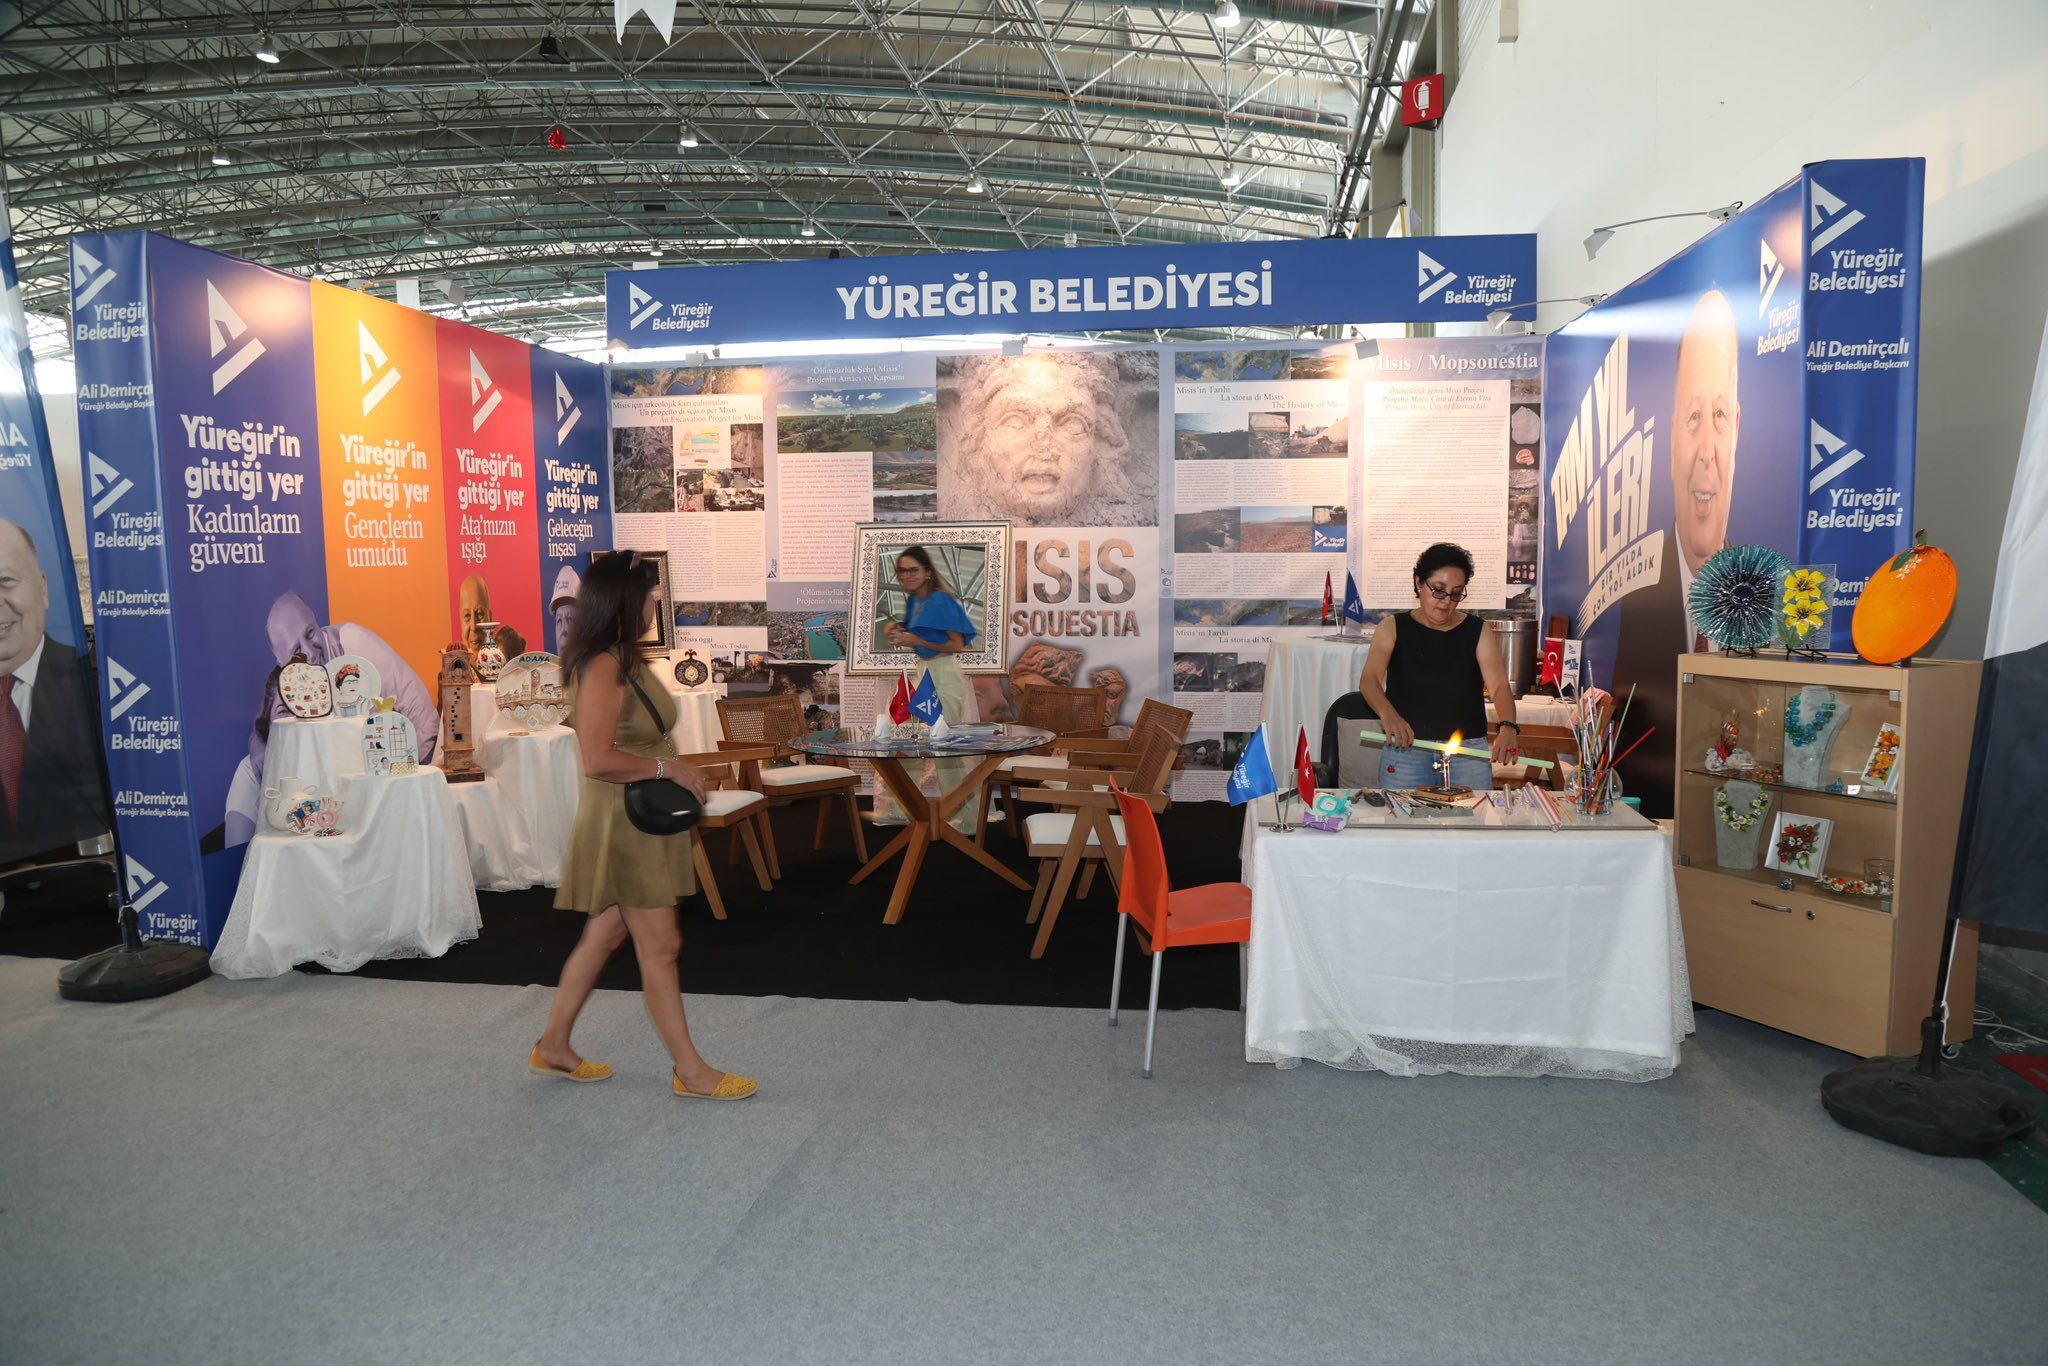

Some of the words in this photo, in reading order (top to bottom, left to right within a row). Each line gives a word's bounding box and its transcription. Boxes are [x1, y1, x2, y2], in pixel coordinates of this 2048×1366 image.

[1830, 248, 1903, 272] Yüreğir
[836, 270, 1017, 320] YÜREĞİR
[1030, 259, 1272, 313] BELEDİYESİ
[1467, 274, 1517, 291] Yüreğir
[1809, 268, 1906, 294] Belediyesi
[1444, 289, 1513, 306] Belediyesi
[670, 302, 713, 318] Yüreğir
[1768, 299, 1800, 329] Yüreğir
[652, 316, 710, 332] Belediyesi
[1757, 320, 1800, 356] Belediyesi
[1807, 341, 1826, 357] Ali
[1828, 338, 1909, 358] Demirçalı
[1429, 353, 1538, 373] Mopsouestia
[1806, 361, 1833, 373] Yüreğir
[1834, 360, 1872, 372] Belediye
[1873, 359, 1909, 371] Başkanı
[79, 384, 98, 398] Ali
[100, 382, 153, 399] Demirçal
[1176, 386, 1206, 394] Misis'in
[1263, 393, 1284, 401] Misis
[80, 402, 105, 411] Yüreğir
[106, 401, 132, 410] Belediye
[613, 401, 631, 409] Misis
[632, 401, 643, 409] için
[1272, 401, 1286, 409] The
[1288, 401, 1314, 410] History
[180, 414, 301, 462] Yüreğir'in
[1550, 385, 1593, 551] TAM
[1594, 329, 1635, 470] YIL
[340, 434, 426, 475] Yüreğir'in
[456, 448, 522, 482] Yüreğir'in
[184, 457, 263, 500] gittiği
[267, 472, 304, 501] yer
[544, 459, 597, 487] Yüreğir'in
[342, 474, 399, 509] gittiği
[403, 486, 429, 510] yer
[458, 481, 501, 511] gittiği
[505, 490, 524, 510] yer
[546, 487, 580, 513] gittiği
[582, 494, 599, 513] yer
[1587, 415, 1655, 585] İLERİ
[1830, 487, 1901, 511] Yüreğir
[186, 504, 301, 534] Kadınların
[344, 512, 424, 545] Gençlerin
[460, 514, 516, 536] Ata'mızın
[548, 518, 593, 541] Geleceğin
[1807, 507, 1903, 532] Belediyesi
[190, 535, 265, 572] güveni
[346, 541, 407, 567] umudu
[461, 536, 487, 564] ışığı
[549, 539, 577, 561] inşası
[1616, 545, 1642, 573] YILDA
[1609, 576, 1622, 596] YOL
[1627, 553, 1655, 582] ALDIK
[97, 590, 114, 604] Ali
[117, 588, 169, 606] Demirçal
[97, 608, 121, 617] Yüreğir
[122, 608, 149, 617] Belediye
[1010, 610, 1140, 637] SOUESTIA
[519, 655, 550, 663] ADANA
[129, 716, 179, 736] Yüreğir
[111, 733, 181, 753] Belediyesi
[115, 791, 132, 804] Ali
[115, 808, 139, 817] Yüreğir
[140, 808, 166, 817] Belediye
[147, 913, 198, 933] Yüreğir
